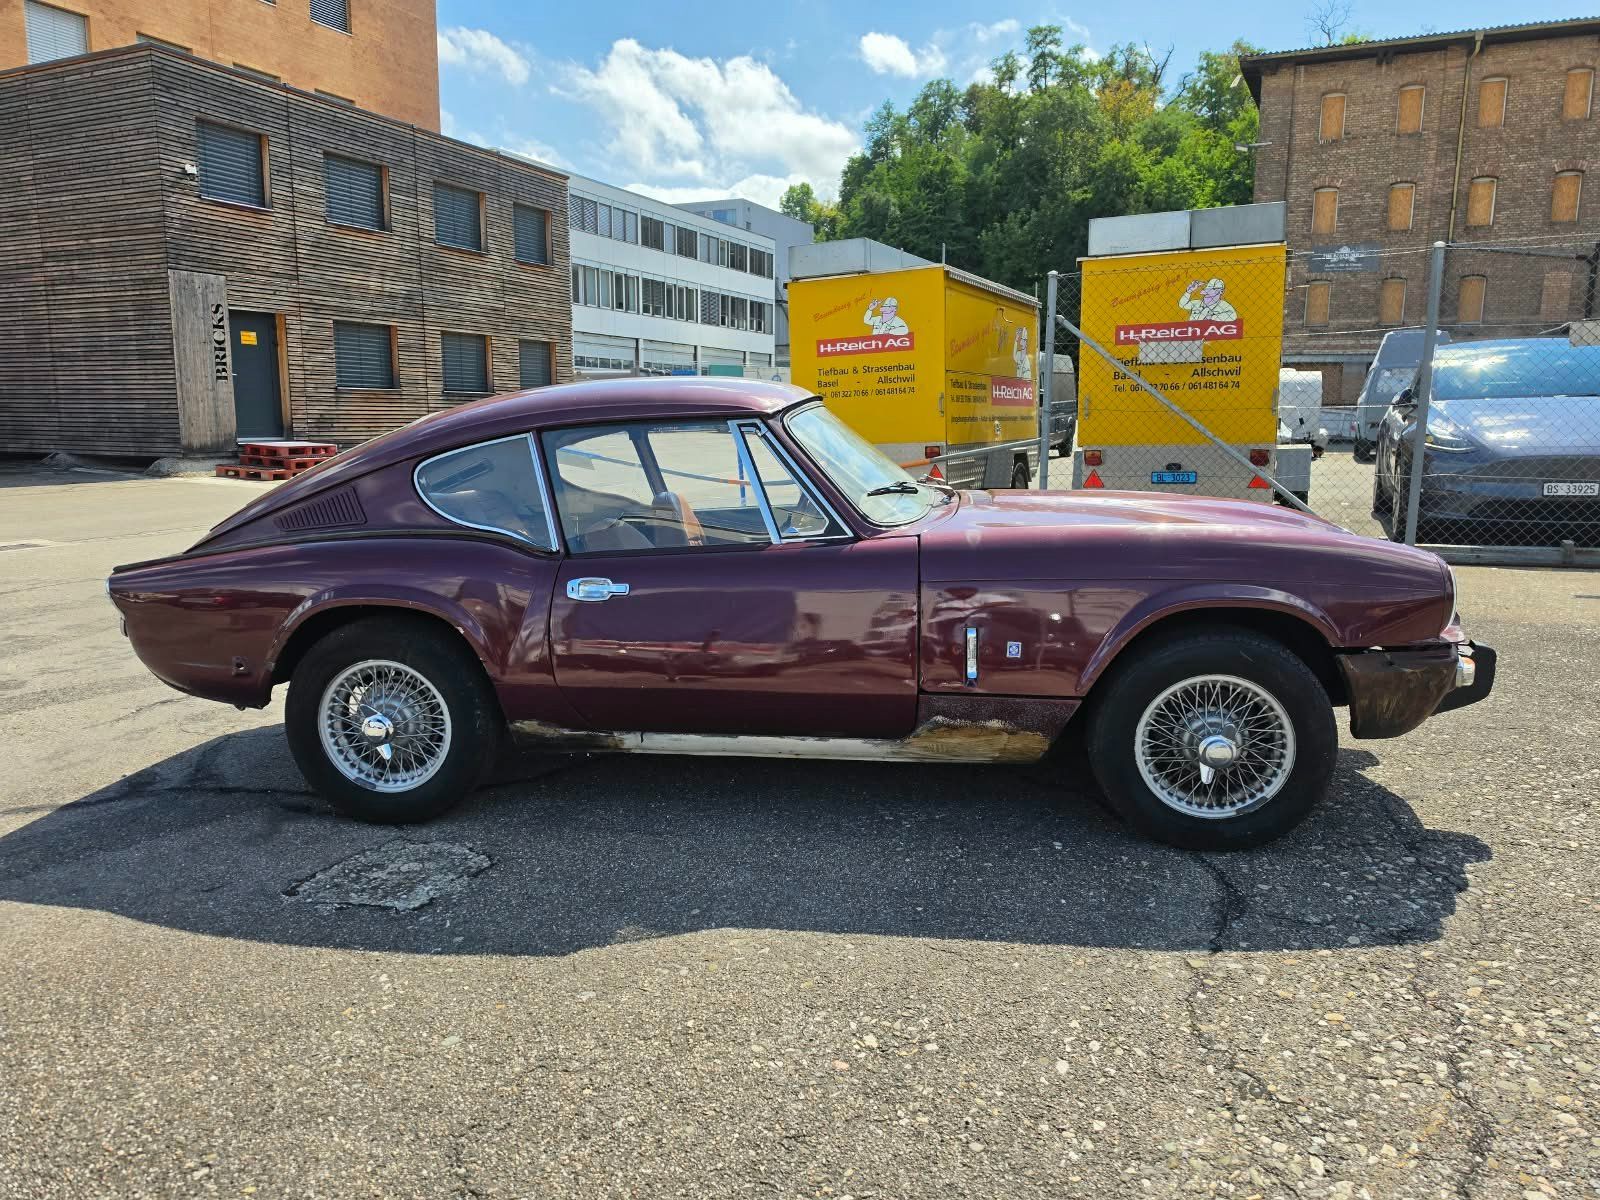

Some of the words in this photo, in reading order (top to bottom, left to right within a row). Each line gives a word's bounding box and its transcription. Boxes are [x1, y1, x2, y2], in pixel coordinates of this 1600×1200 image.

[1204, 324, 1238, 336] AG
[211, 304, 228, 381] BRICKS
[820, 340, 882, 353] H.Reich
[885, 337, 911, 348] AG
[818, 367, 849, 377] Tiefbau
[853, 366, 859, 375] &
[862, 363, 915, 374] Strassenbau
[1191, 366, 1241, 377] Allschwil
[818, 380, 839, 388] Basel
[877, 374, 915, 384] Allschwil
[1022, 387, 1033, 400] AG
[1114, 384, 1126, 392] Tel.
